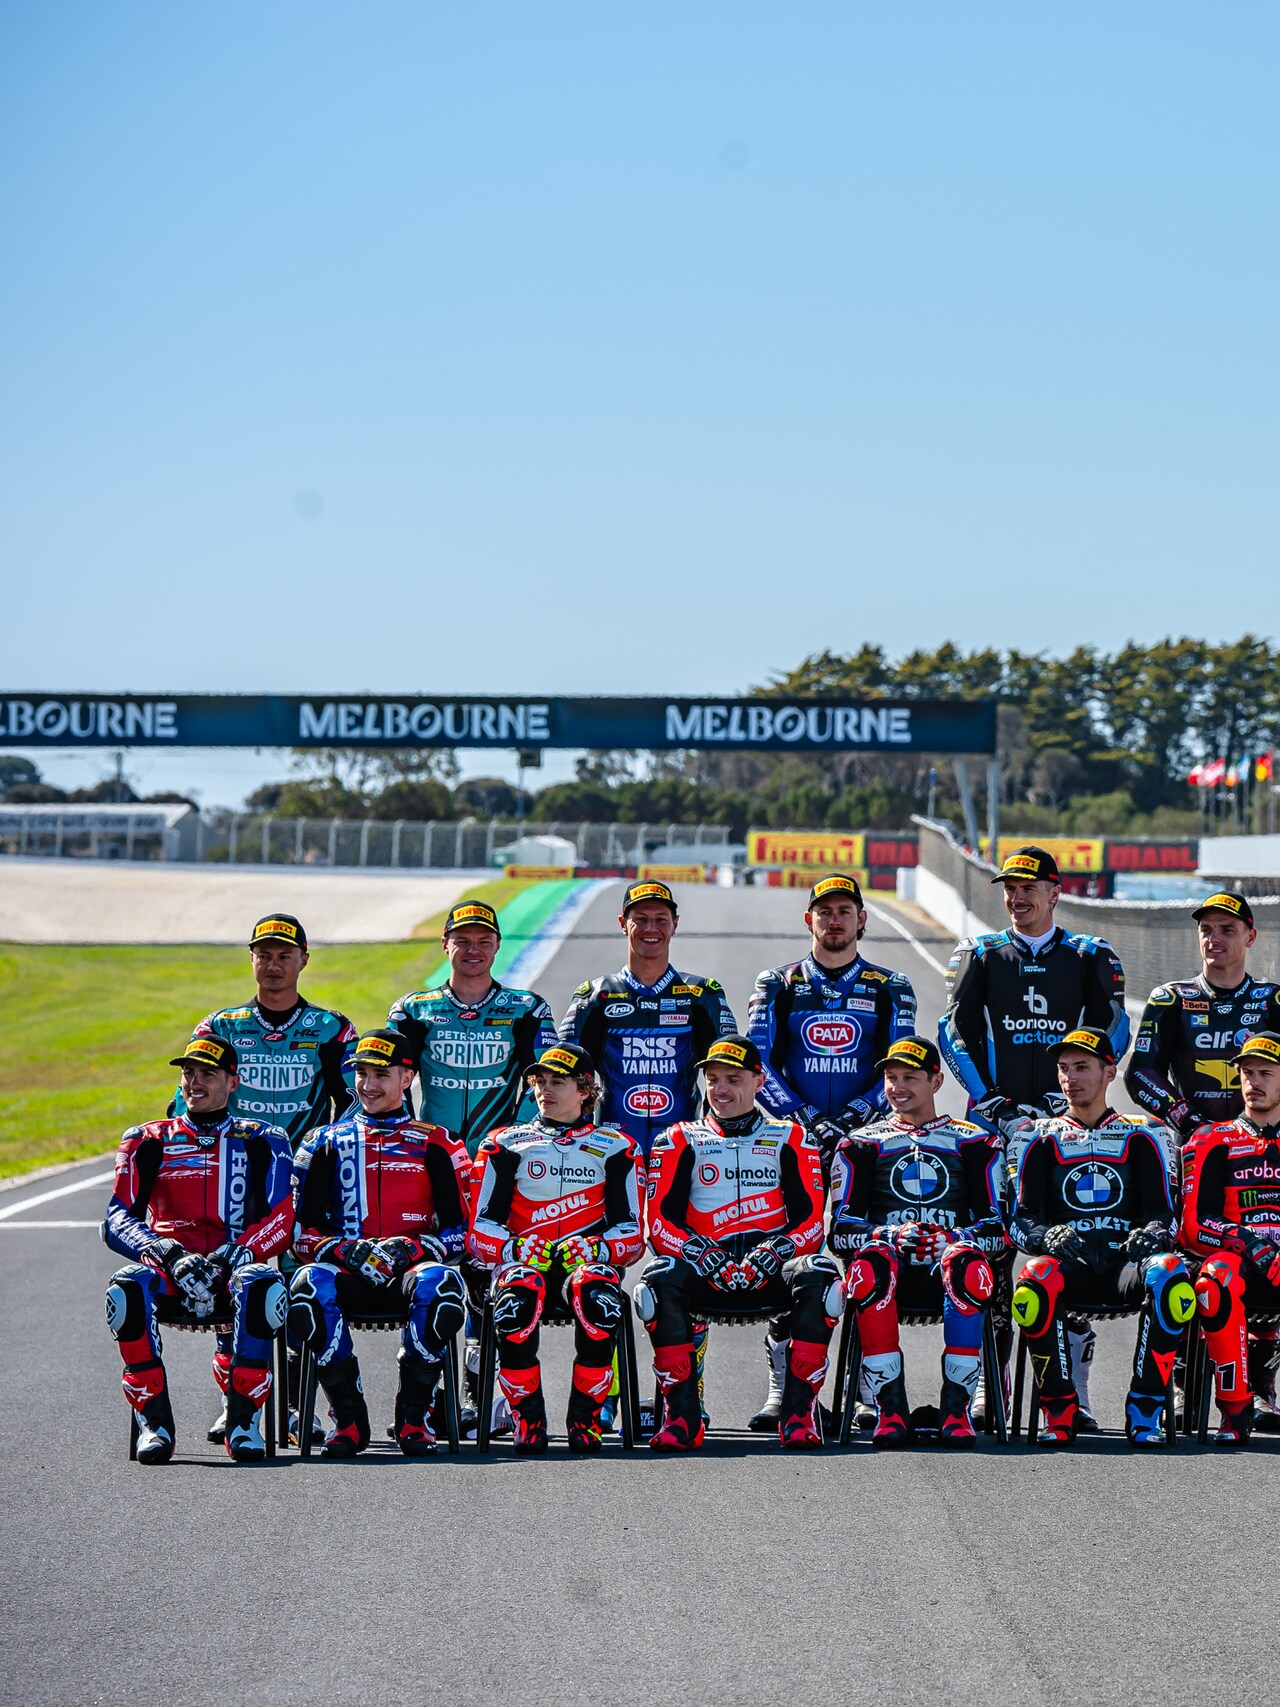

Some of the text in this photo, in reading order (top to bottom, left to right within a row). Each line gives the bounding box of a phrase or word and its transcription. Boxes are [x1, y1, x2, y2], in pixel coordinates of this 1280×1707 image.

[0, 701, 178, 738] BOURNE
[300, 702, 550, 740] MELBOURNE
[665, 704, 911, 743] MELBOURNE
[756, 837, 854, 864] PIRELLI
[1107, 844, 1198, 871] DIABL
[842, 963, 861, 982] YAMAHA
[652, 971, 675, 995] YAMAHA
[609, 1004, 632, 1014] Arai
[1188, 1002, 1208, 1010] Beta
[1003, 1014, 1067, 1031] bonovo
[234, 1039, 255, 1047] Arai
[437, 1031, 502, 1040] PETRONAS
[813, 1027, 850, 1041] PATA
[1195, 1030, 1234, 1049] elf
[241, 1053, 307, 1064] PETRONAS
[433, 1043, 506, 1065] SPRINTA
[622, 1059, 678, 1074] YAMAHA
[804, 1057, 858, 1073] YAMAHA
[238, 1065, 311, 1087] SPRINTA
[430, 1076, 508, 1090] HONDA
[237, 1099, 313, 1114] HONDA
[633, 1095, 664, 1106] PATA
[550, 1165, 596, 1178] bimota
[725, 1167, 777, 1180] bimota
[1070, 1164, 1116, 1182] BMW
[402, 1213, 427, 1222] SBK
[531, 1194, 590, 1223] MOTUL
[713, 1197, 770, 1226] MOTUL
[887, 1207, 957, 1227] ROKiT
[1198, 1232, 1221, 1246] Lenovo
[1056, 1319, 1069, 1381] DAINESE
[1136, 1313, 1151, 1378] DAINESE
[1218, 1362, 1235, 1390] 1
